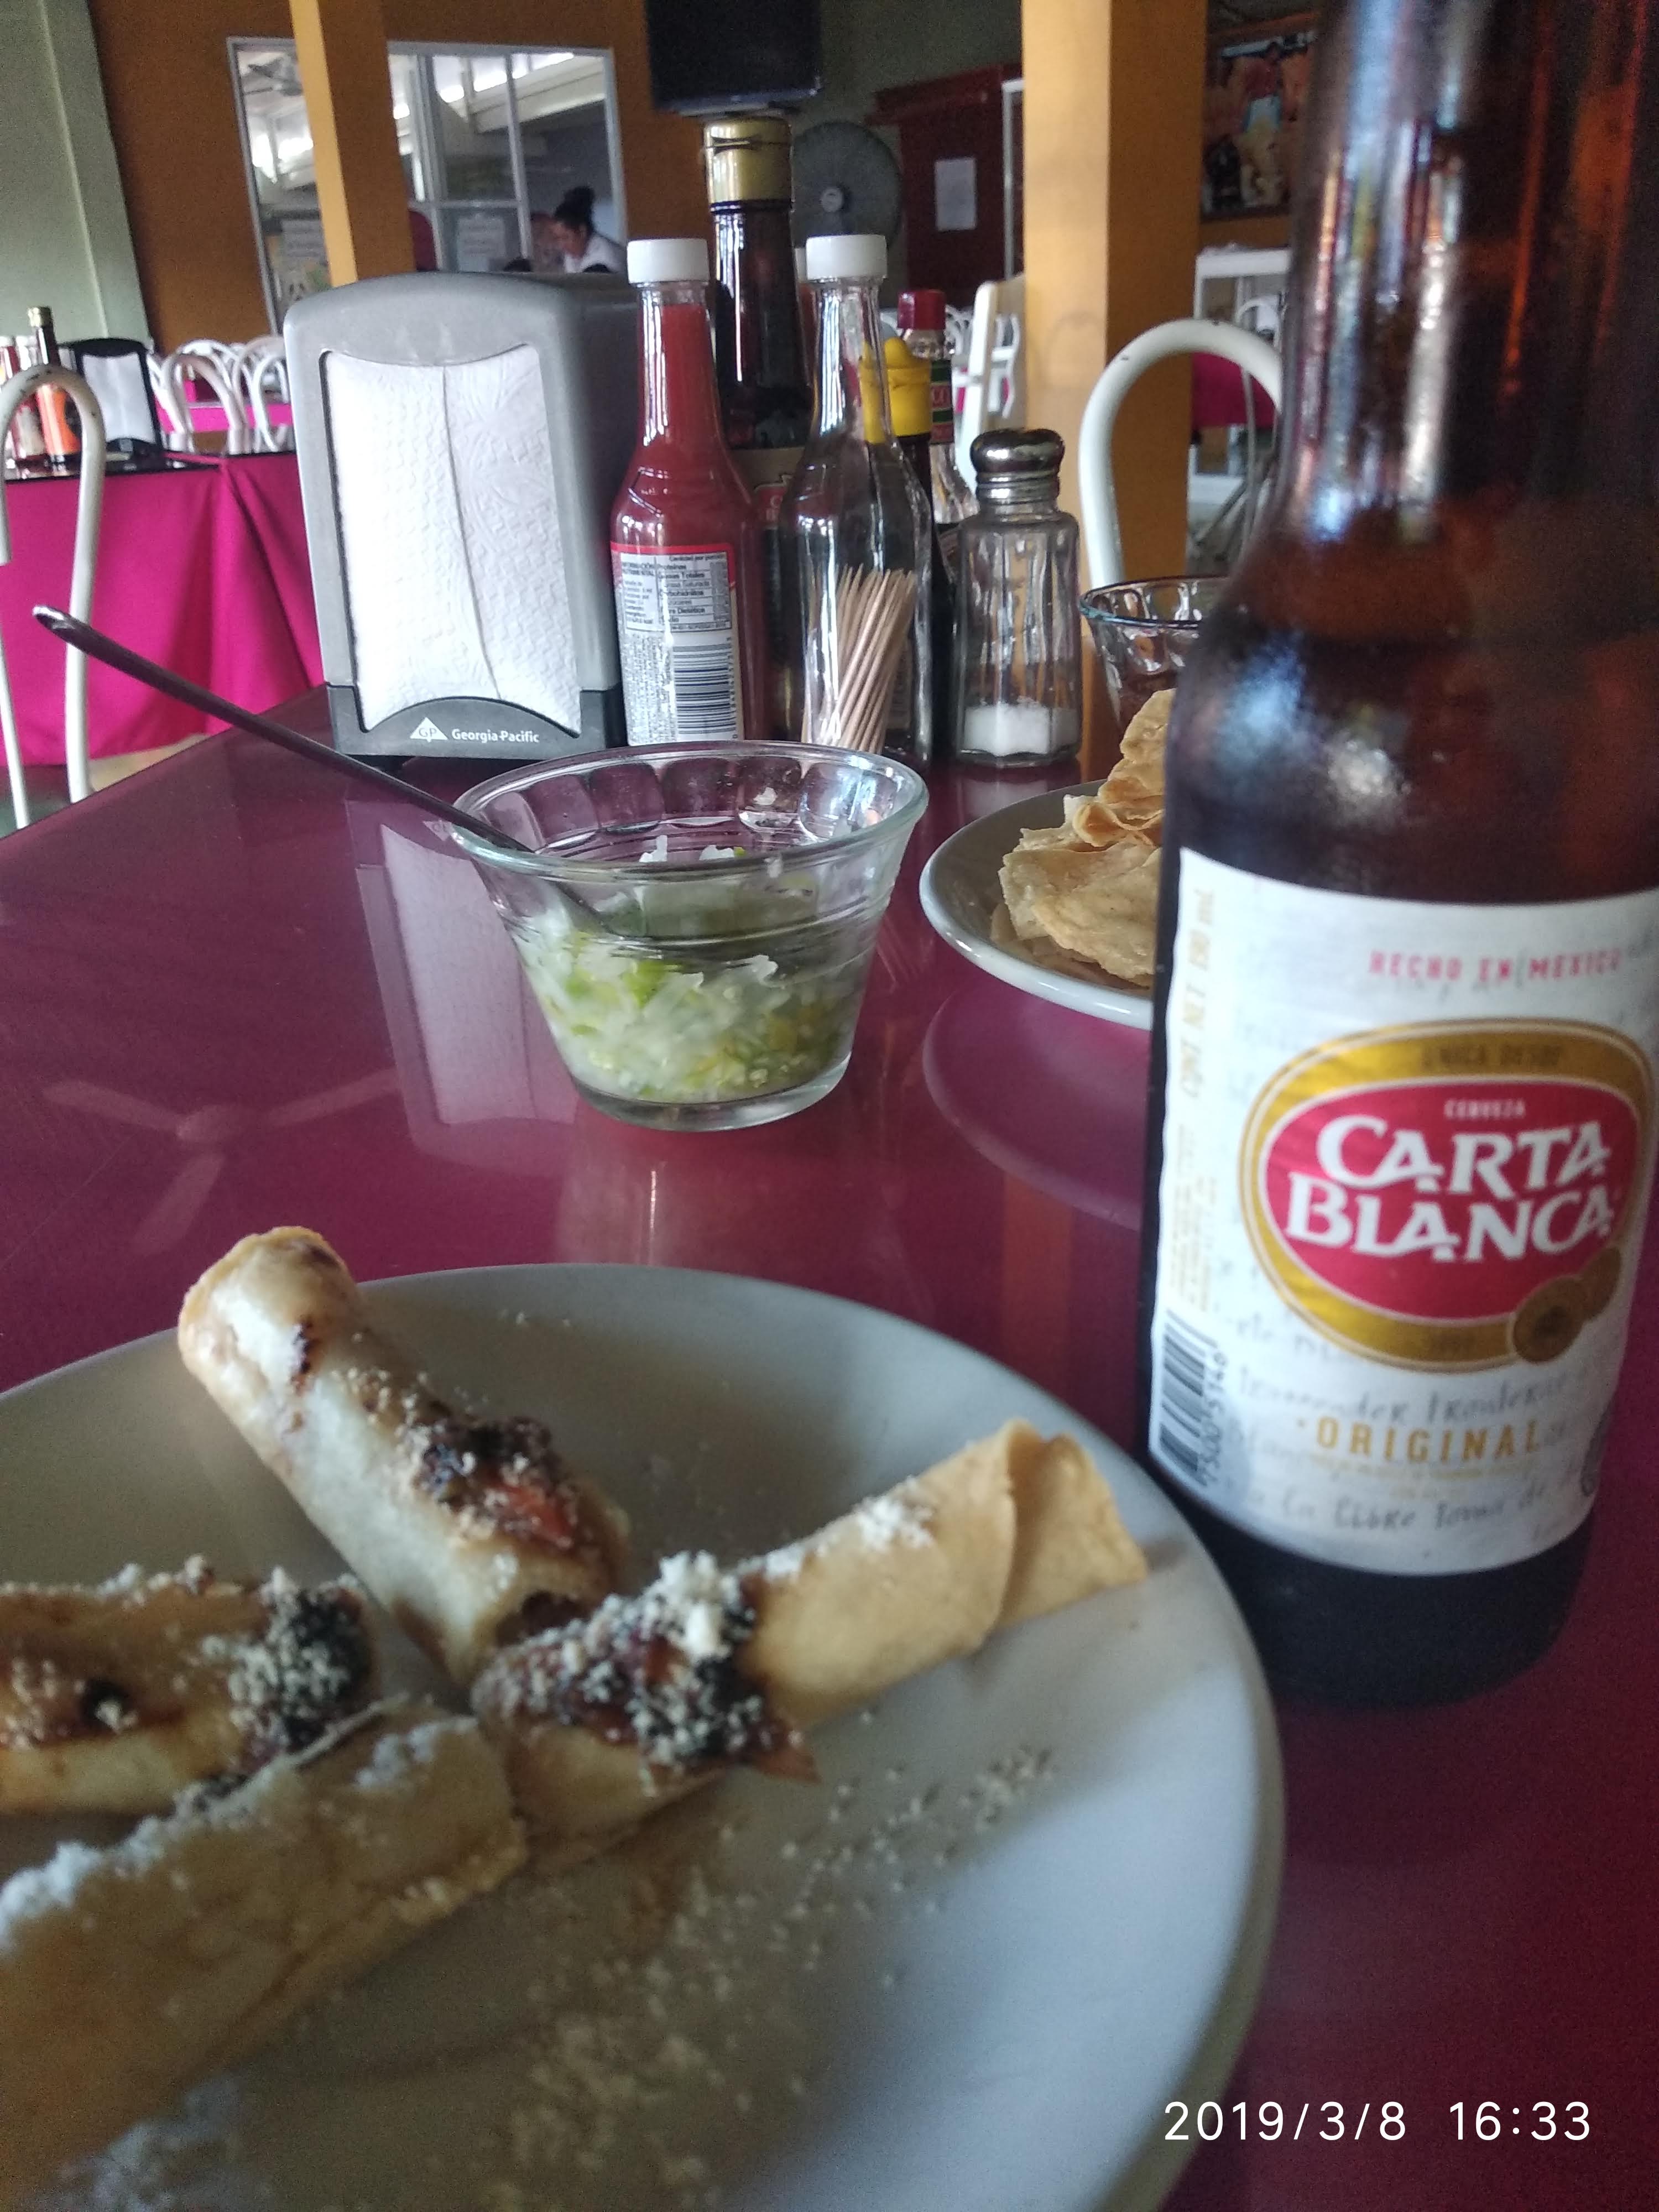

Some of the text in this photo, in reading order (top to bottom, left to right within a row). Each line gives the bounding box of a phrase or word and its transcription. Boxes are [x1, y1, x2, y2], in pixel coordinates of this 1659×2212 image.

[452, 728, 540, 743] Georgia-Pacific
[1370, 950, 1463, 980] HECHO
[1478, 958, 1512, 983] EN
[1316, 1114, 1611, 1201] CARTA
[1285, 1171, 1614, 1263] BLANCA
[1317, 1417, 1541, 1465] ORIGINAL
